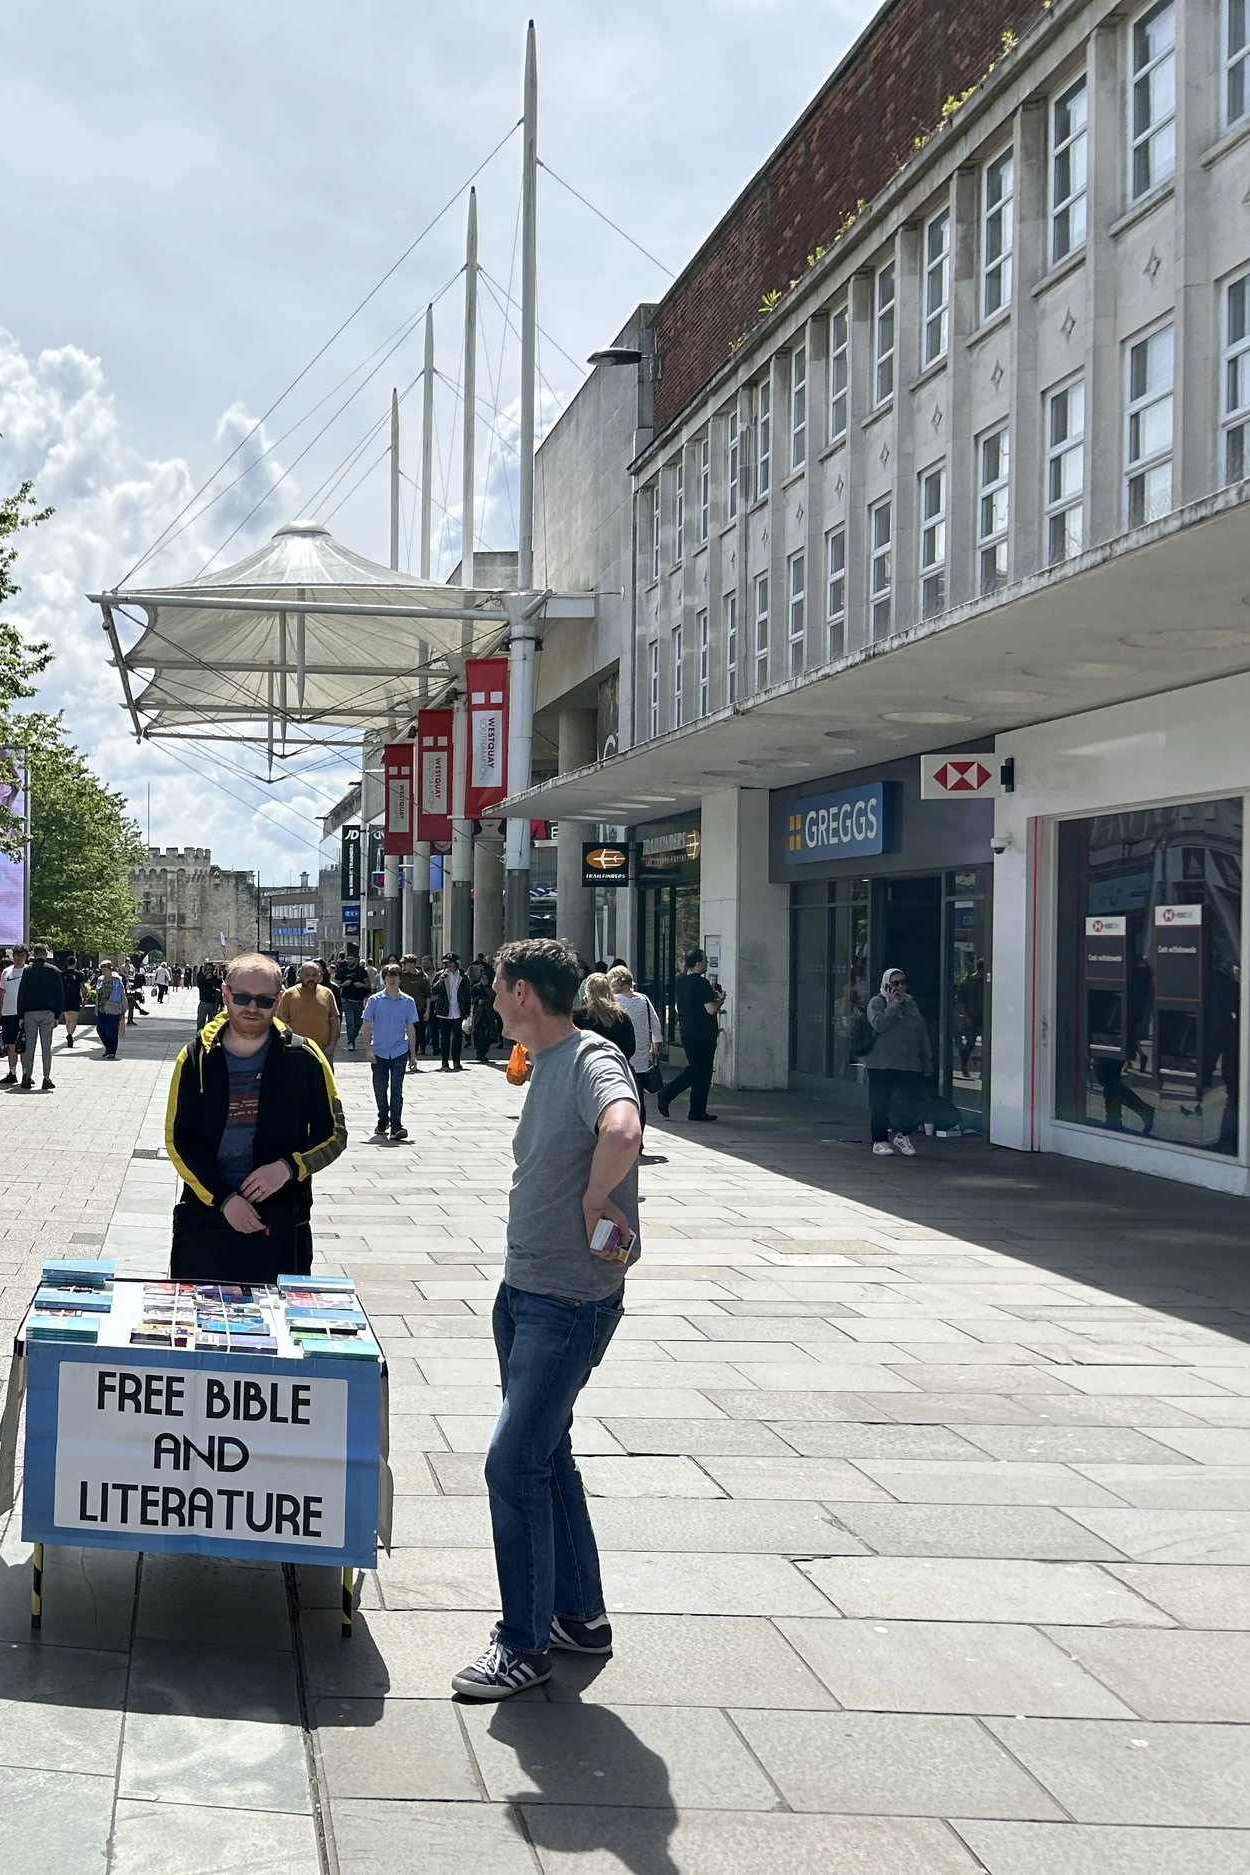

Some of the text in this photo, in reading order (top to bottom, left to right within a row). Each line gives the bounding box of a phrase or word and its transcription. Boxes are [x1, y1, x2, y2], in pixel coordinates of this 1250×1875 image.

[487, 717, 495, 769] WESTQUAY
[434, 757, 442, 799] WESTQUAY
[344, 829, 359, 840] JD
[805, 797, 878, 849] GREGGS
[97, 1371, 310, 1425] FREE BIBLE
[154, 1432, 250, 1473] AND
[79, 1481, 323, 1538] LITERATURE
